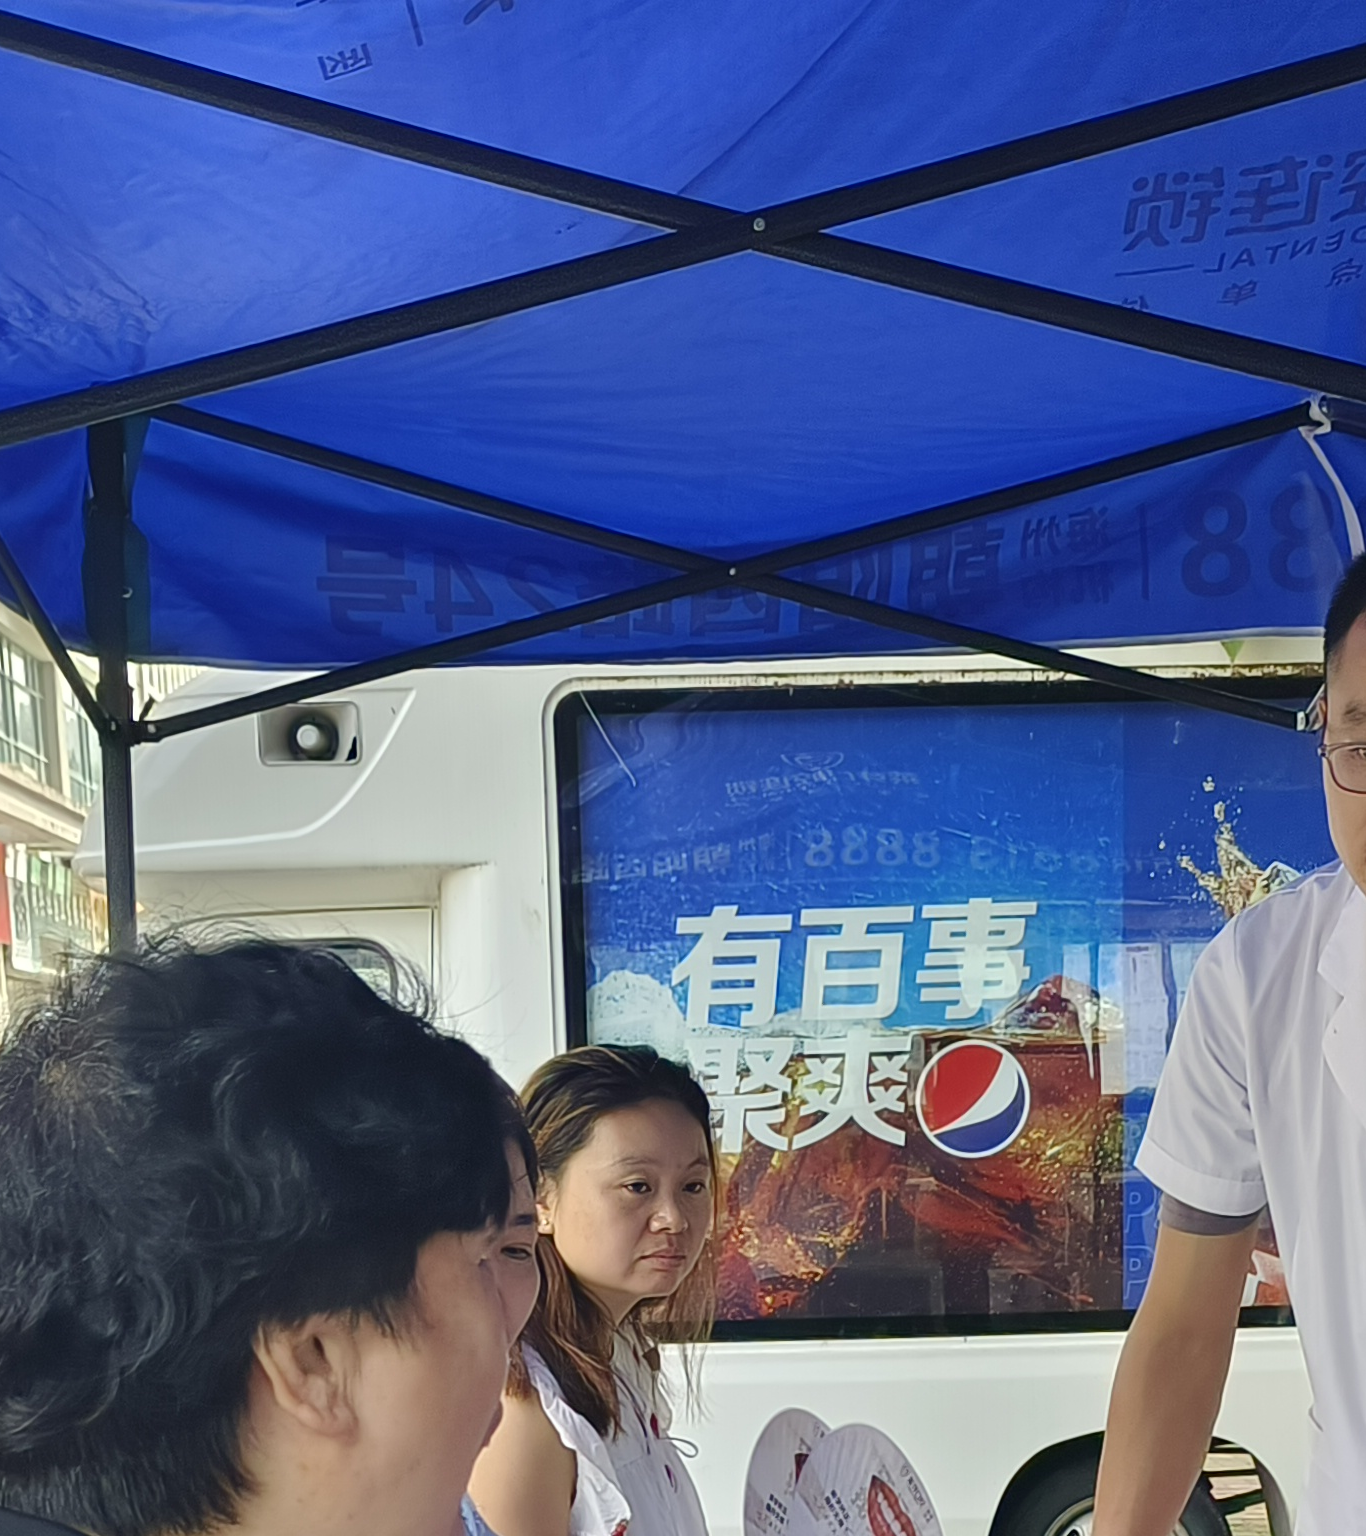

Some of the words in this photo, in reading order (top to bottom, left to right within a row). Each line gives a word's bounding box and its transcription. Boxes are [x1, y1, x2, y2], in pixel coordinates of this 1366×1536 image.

[671, 897, 1038, 1028] 有百事
[685, 1034, 908, 1156] 聚爽
